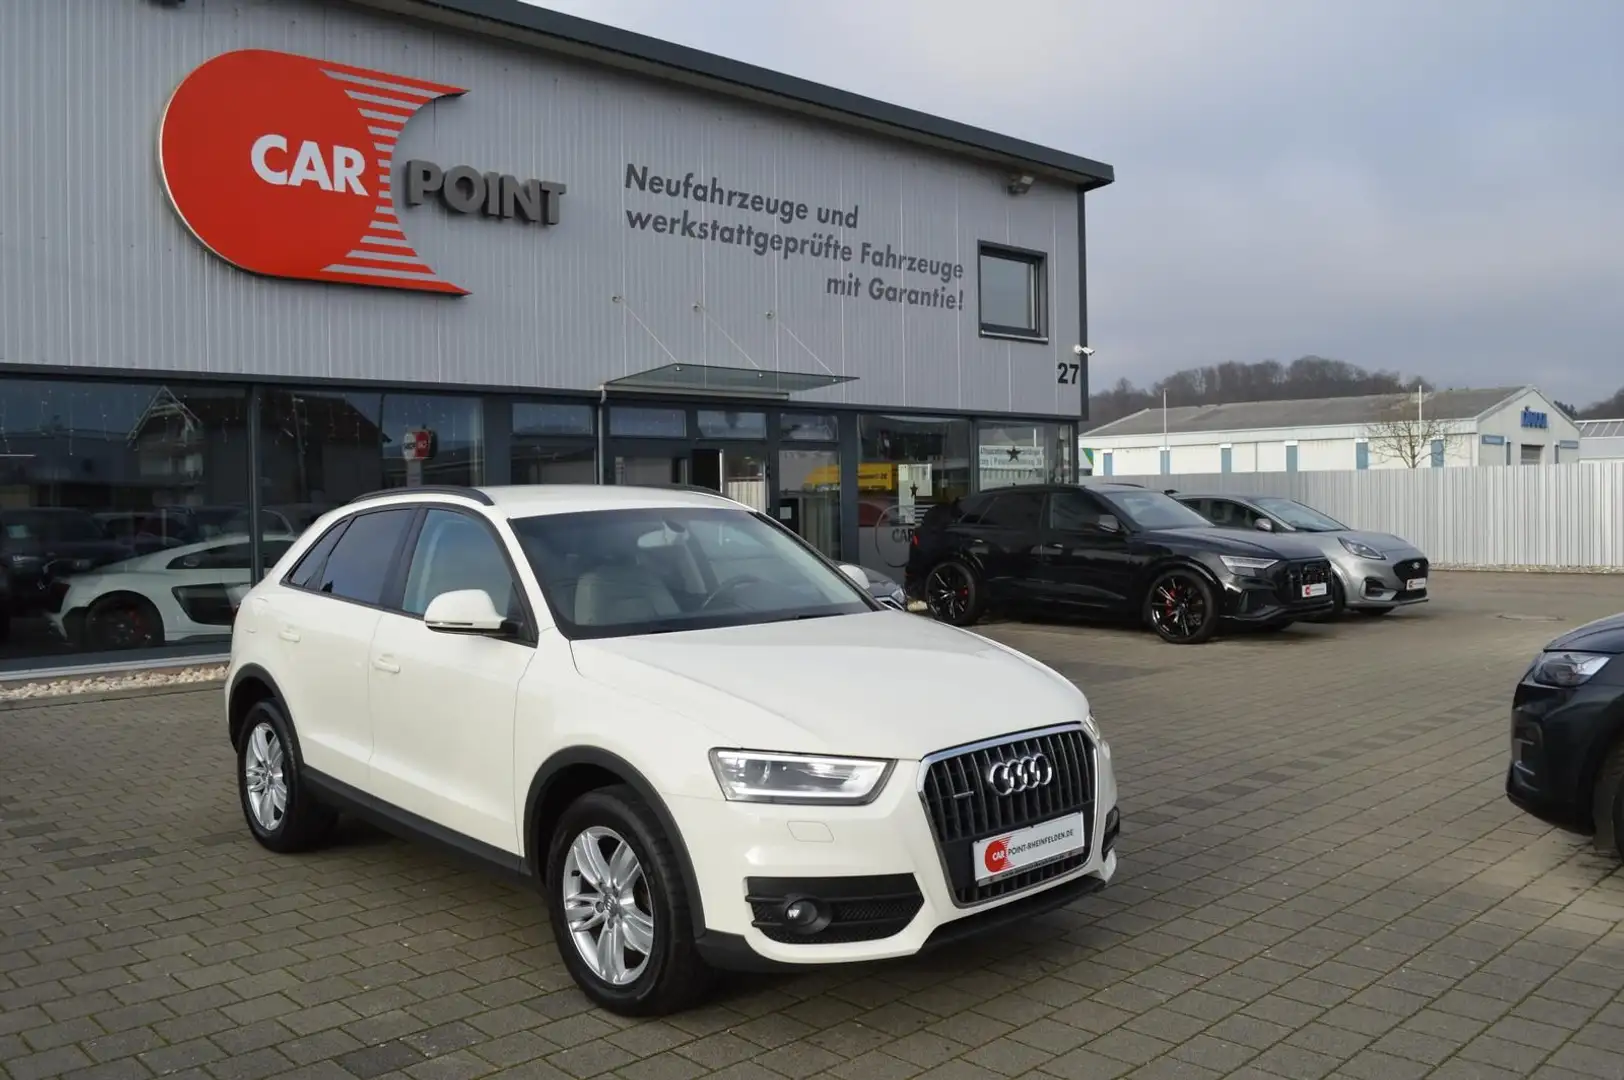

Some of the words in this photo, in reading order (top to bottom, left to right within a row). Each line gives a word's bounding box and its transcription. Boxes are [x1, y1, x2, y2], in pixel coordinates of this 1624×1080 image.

[251, 134, 369, 196] CAR
[406, 159, 567, 225] POINT
[625, 163, 809, 223] Neufahrzeuge
[817, 206, 859, 229] und
[626, 209, 853, 260] werkstattgeprüfte
[860, 242, 964, 283] Fahrzeuge
[826, 273, 861, 298] mit
[868, 278, 964, 311] Garantie!
[1057, 362, 1080, 385] 27
[992, 850, 1005, 862] CAR
[1007, 828, 1074, 856] POINT-RHEINFELDEN.DE
